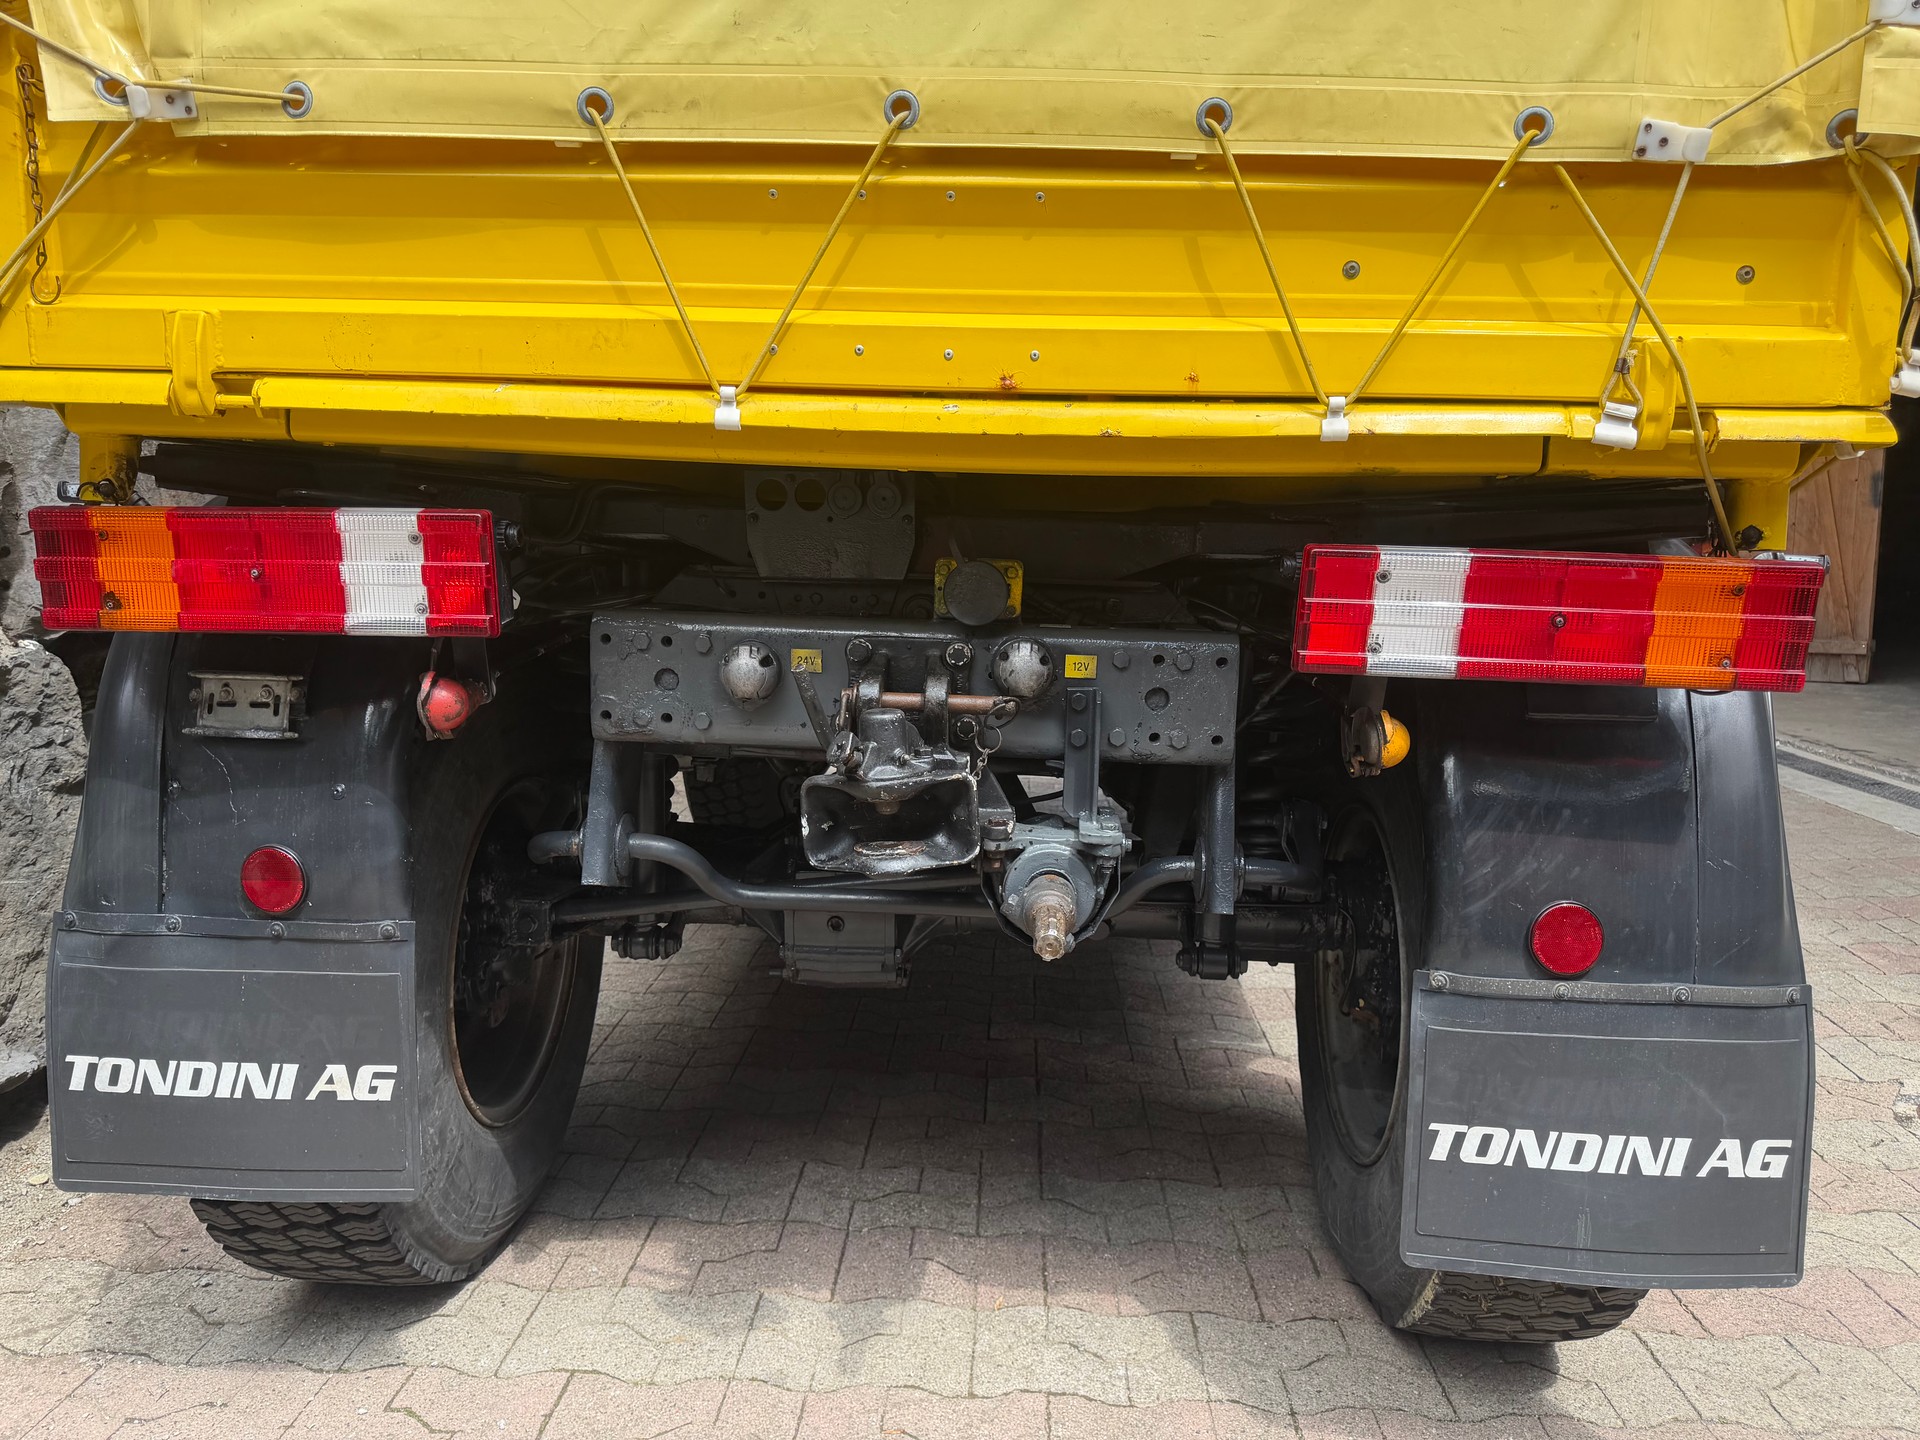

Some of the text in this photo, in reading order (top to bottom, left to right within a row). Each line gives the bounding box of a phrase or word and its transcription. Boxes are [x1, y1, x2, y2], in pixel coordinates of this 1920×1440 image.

[796, 655, 816, 666] 24V
[1072, 661, 1090, 672] 12V
[65, 1055, 398, 1101] TONDINI AG
[1428, 1122, 1792, 1178] TONDINI AG
